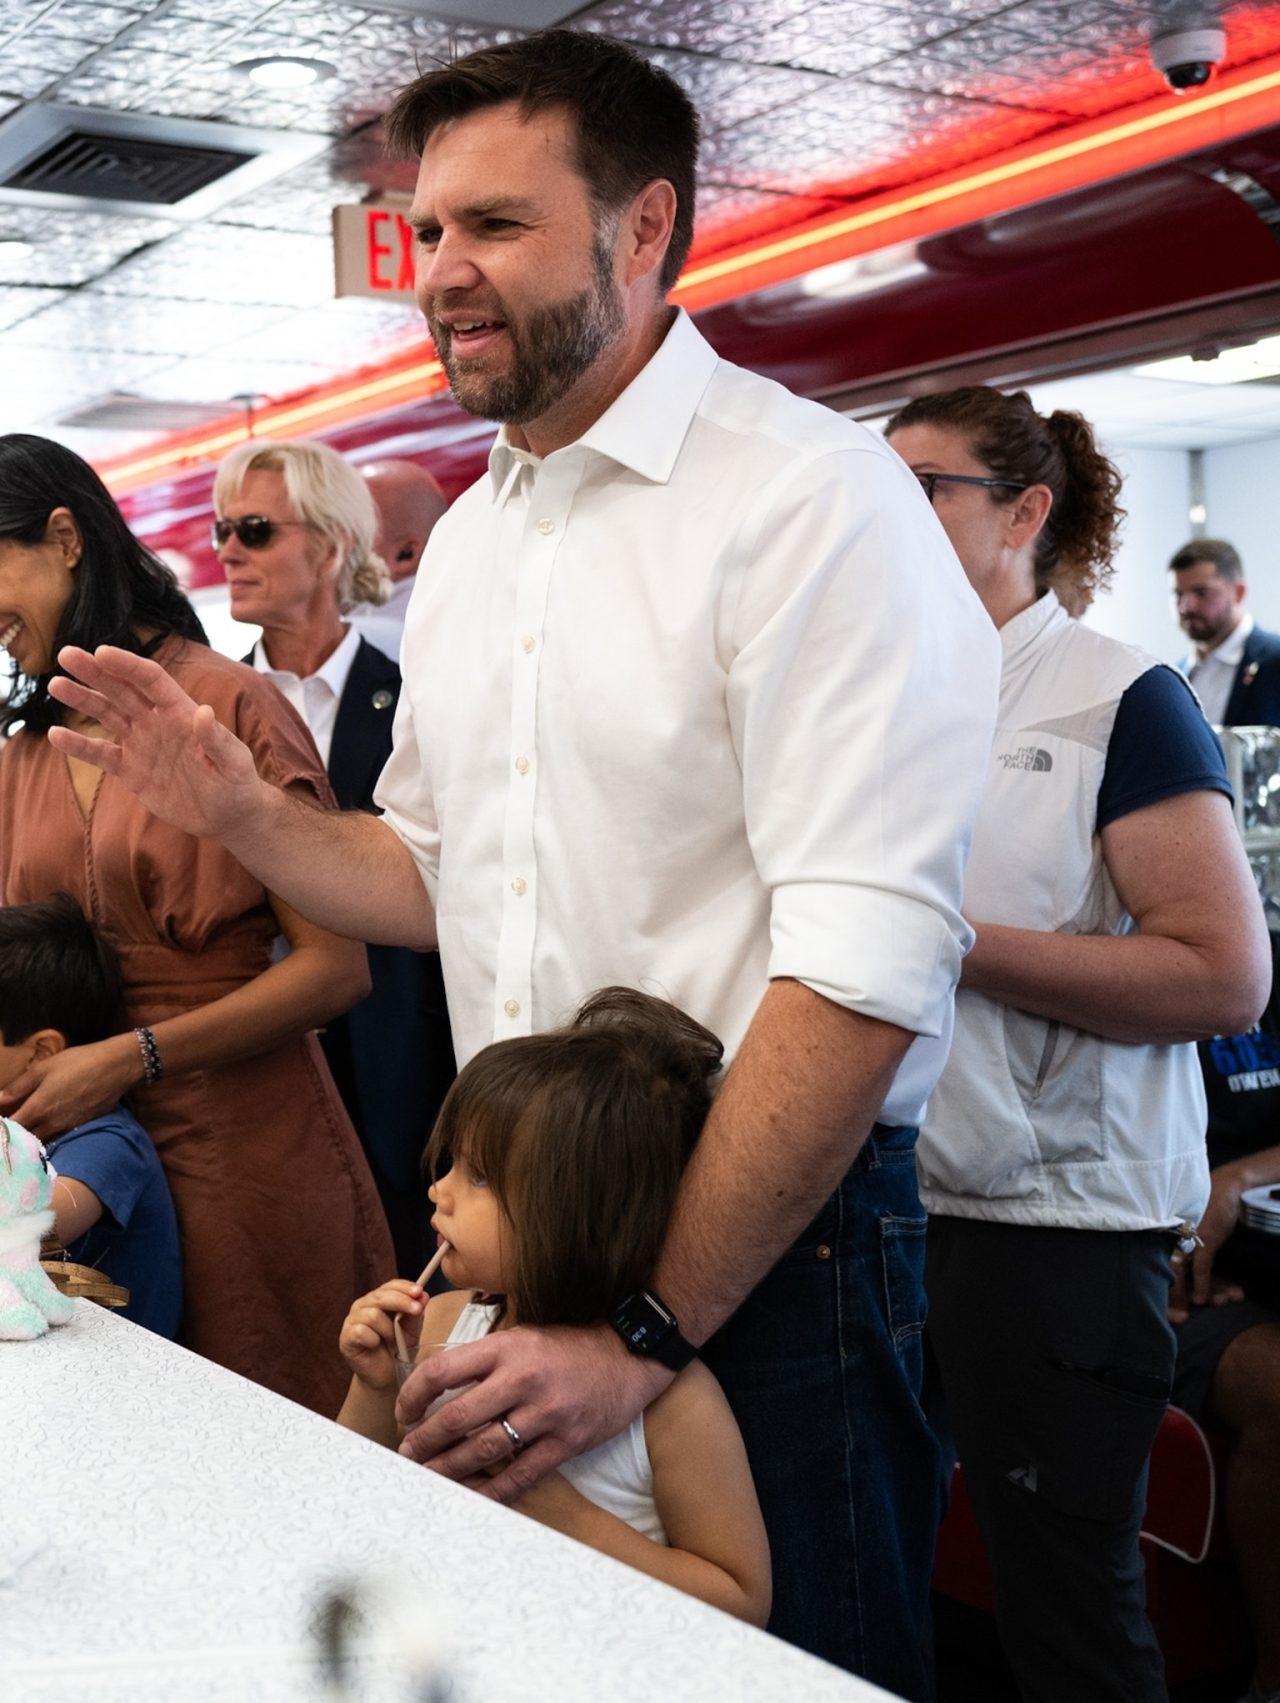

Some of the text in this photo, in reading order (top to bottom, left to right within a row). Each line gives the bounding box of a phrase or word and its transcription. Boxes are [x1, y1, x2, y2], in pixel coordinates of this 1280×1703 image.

[367, 211, 415, 290] EX
[1017, 746, 1036, 754] THE
[1003, 761, 1031, 771] FACE
